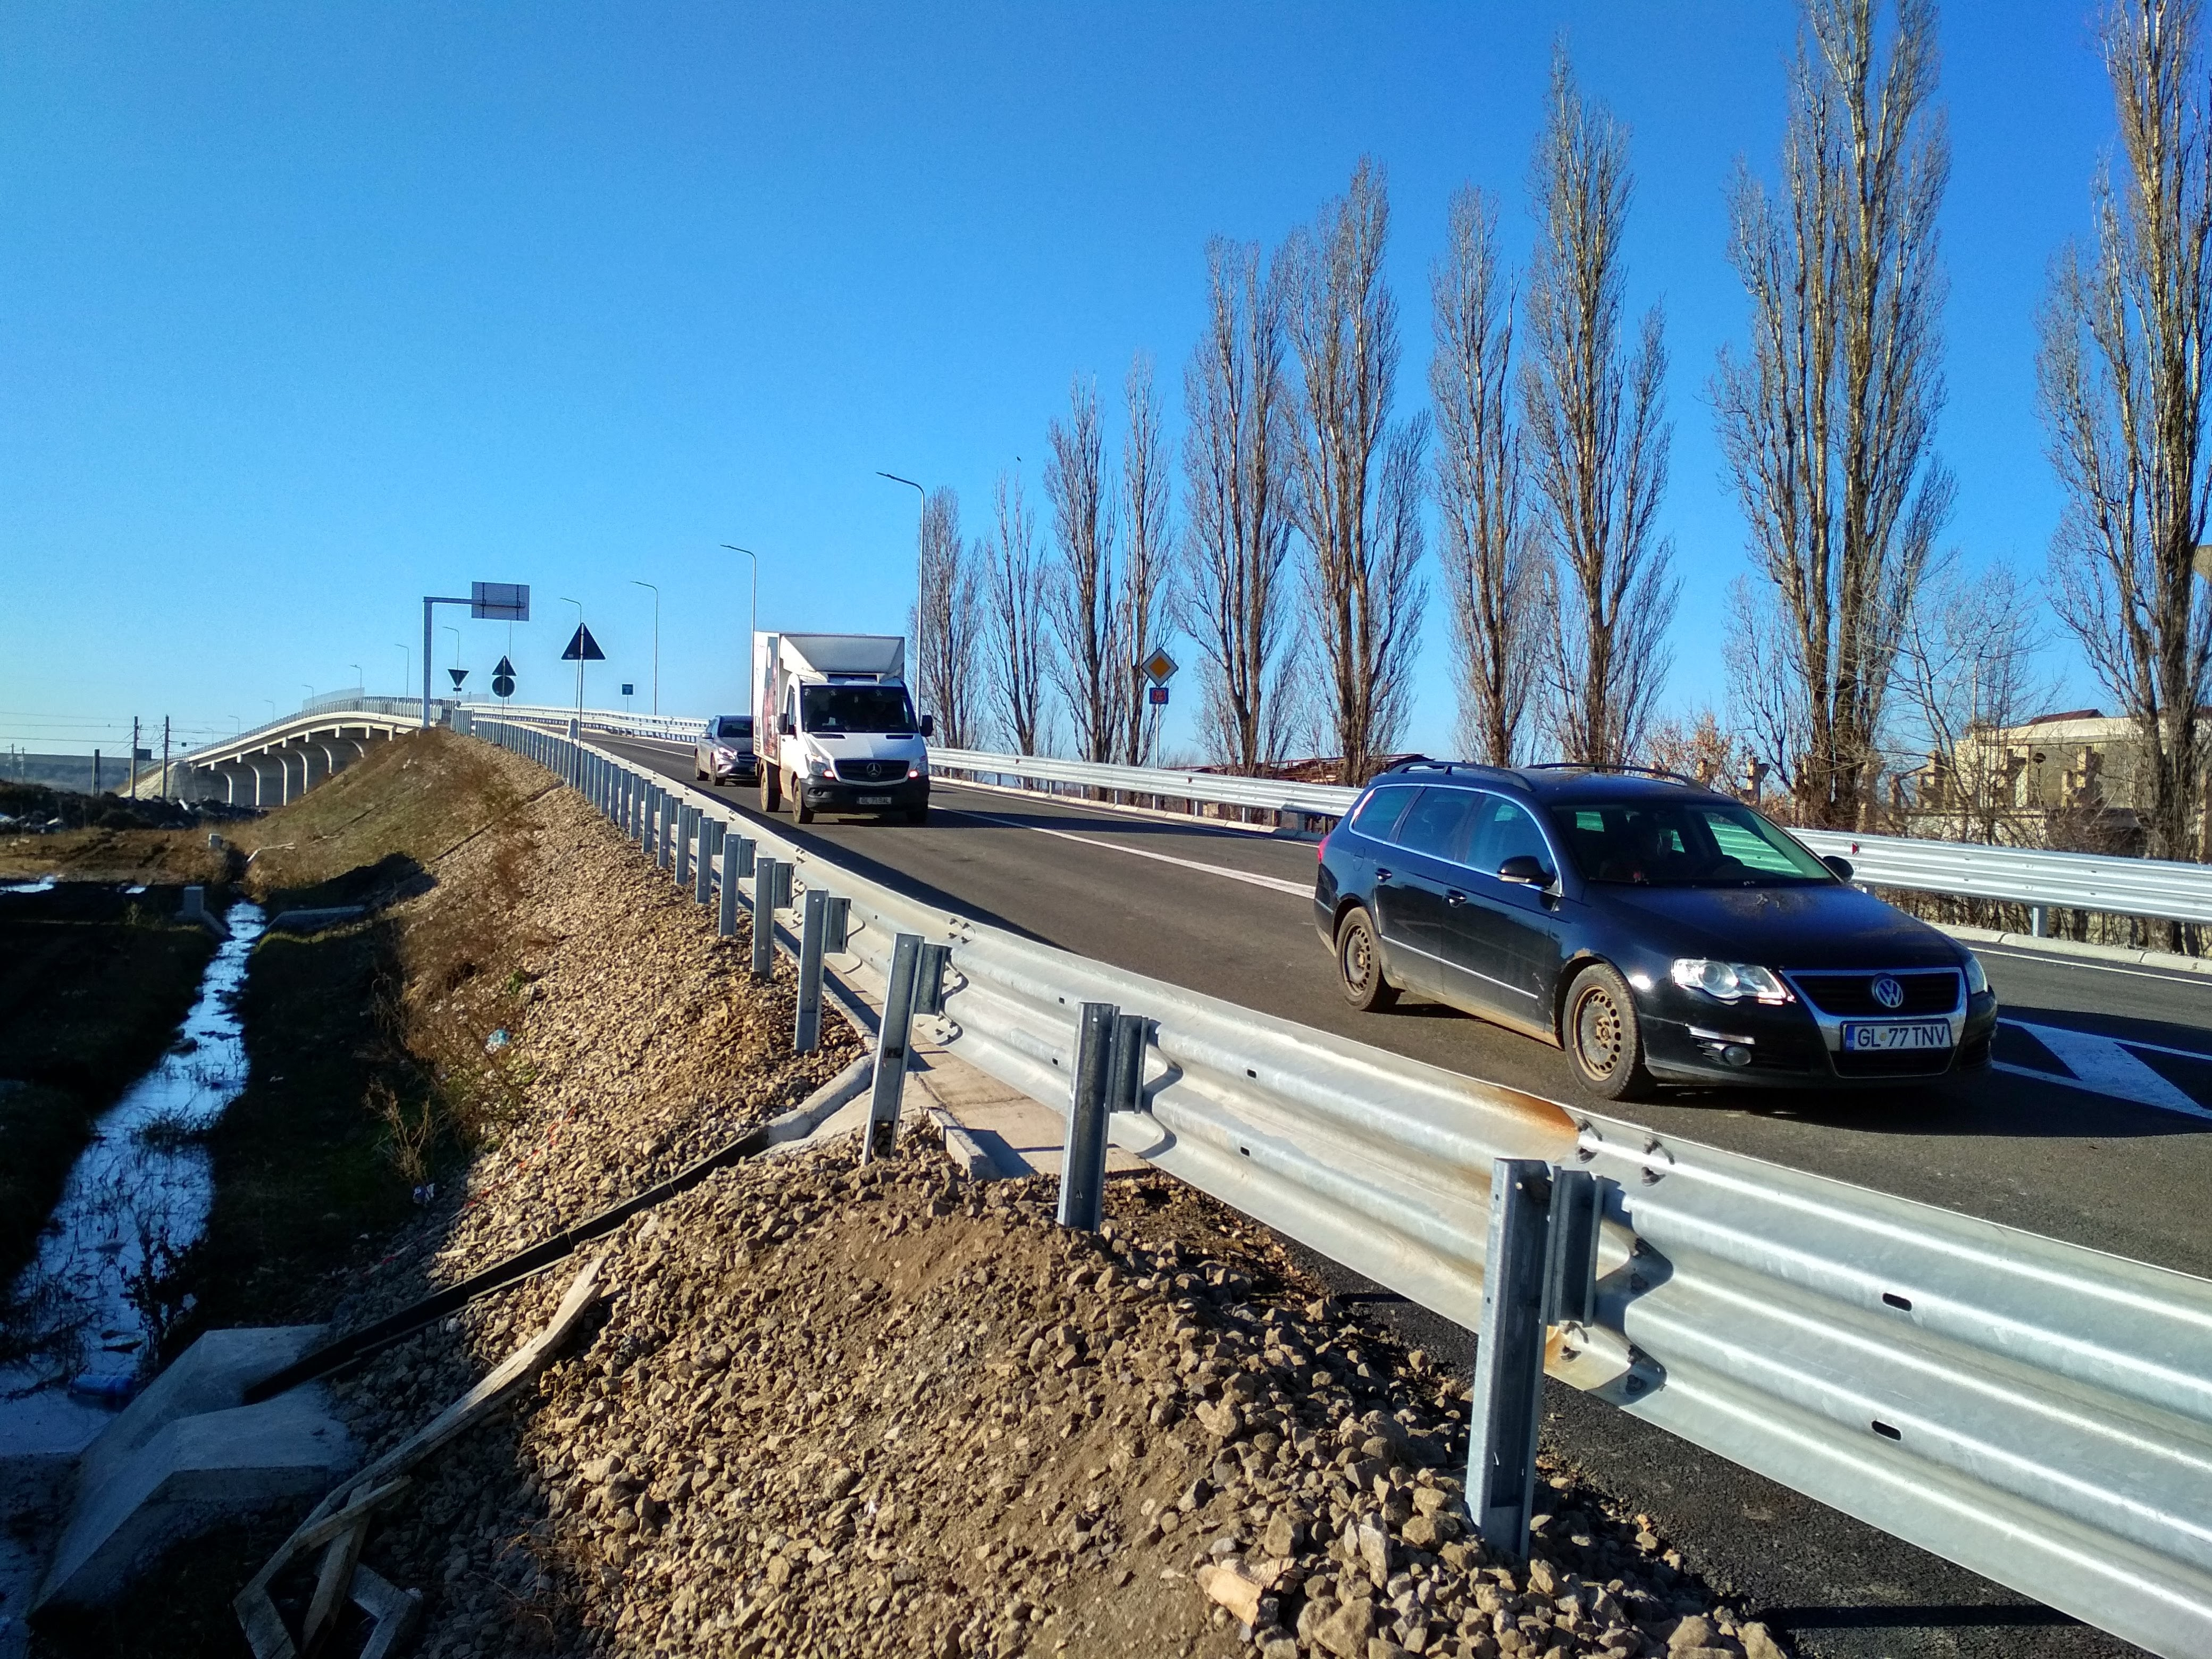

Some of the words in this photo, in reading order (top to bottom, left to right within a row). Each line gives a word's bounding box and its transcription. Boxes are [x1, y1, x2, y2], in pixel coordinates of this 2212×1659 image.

[1858, 1028, 1881, 1047] GL
[1889, 1028, 1909, 1046] 77
[1912, 1026, 1945, 1046] TNV
